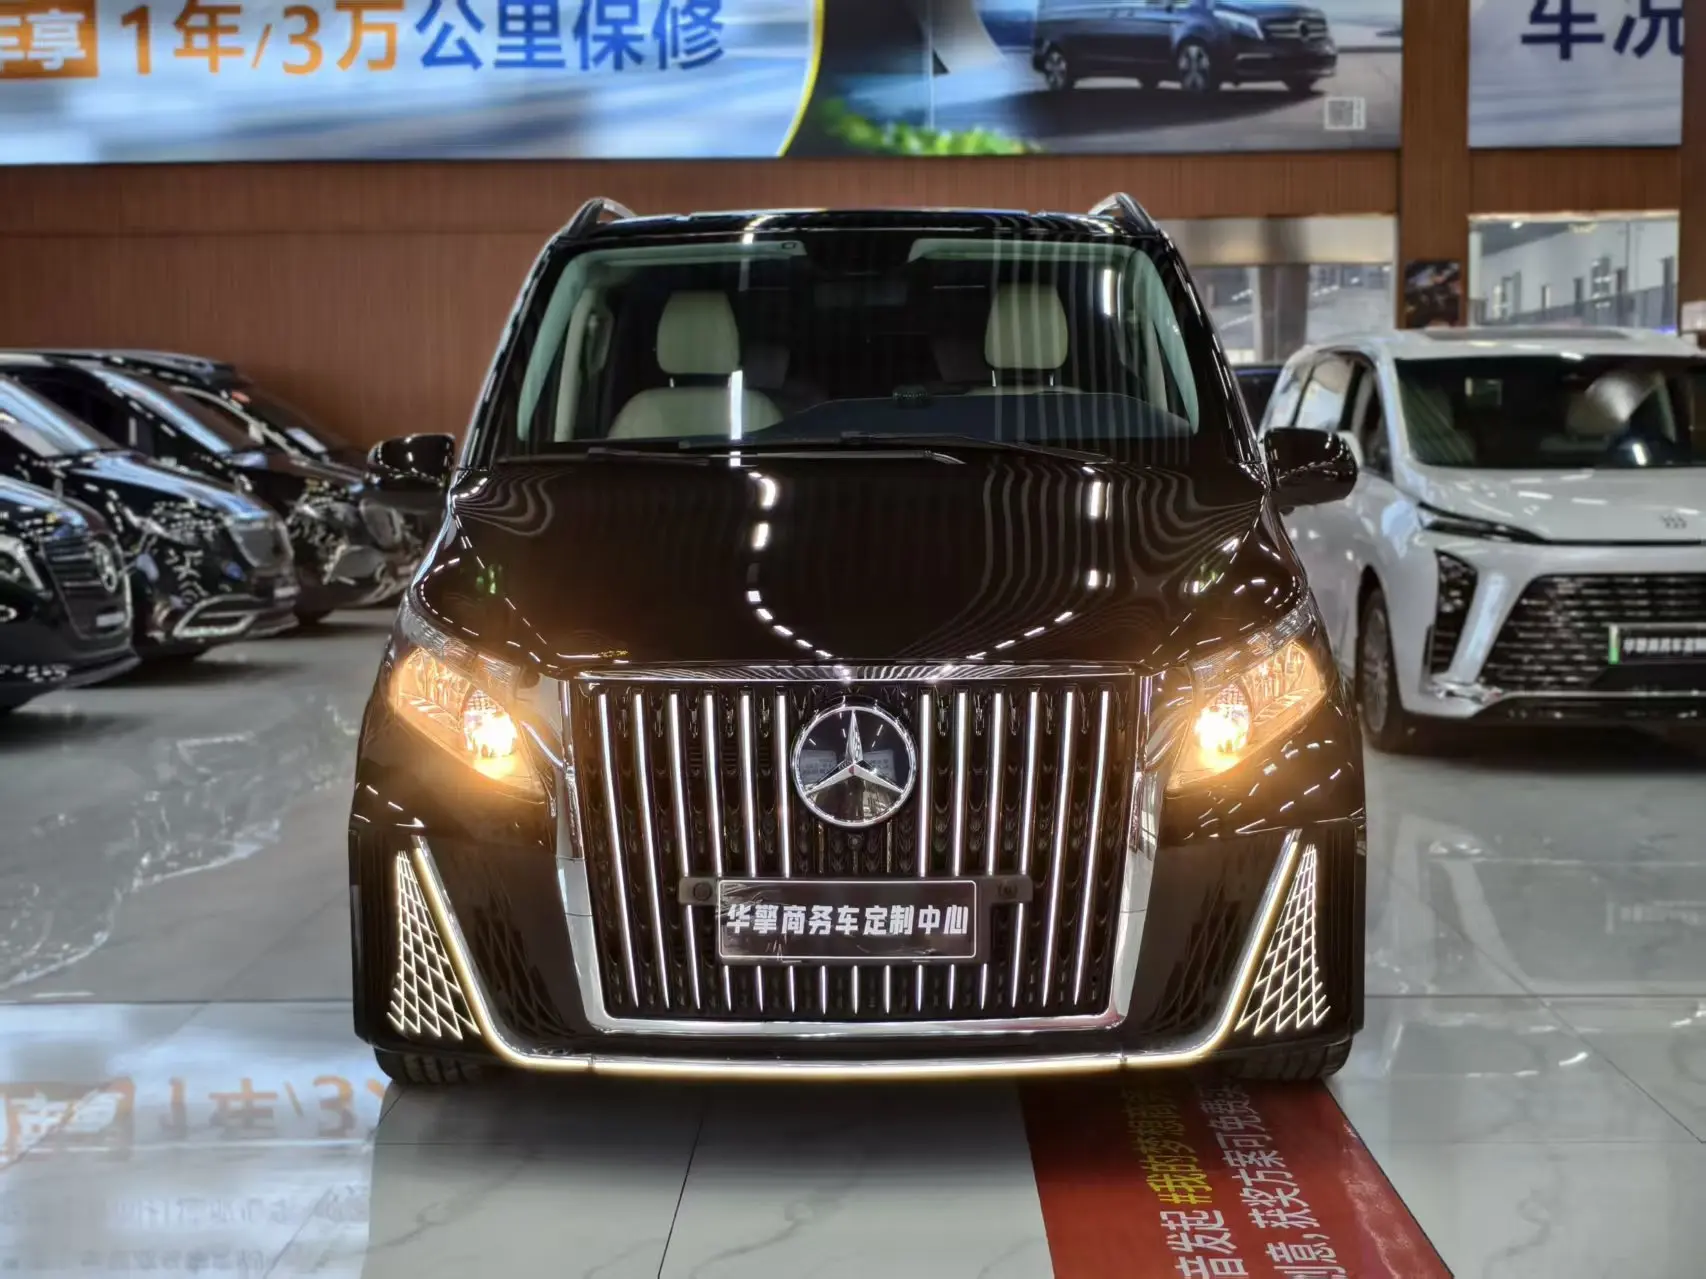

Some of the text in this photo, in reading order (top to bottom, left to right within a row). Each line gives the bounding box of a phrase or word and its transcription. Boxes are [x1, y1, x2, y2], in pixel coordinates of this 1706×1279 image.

[726, 903, 970, 936] 华擎商务车定制中心
